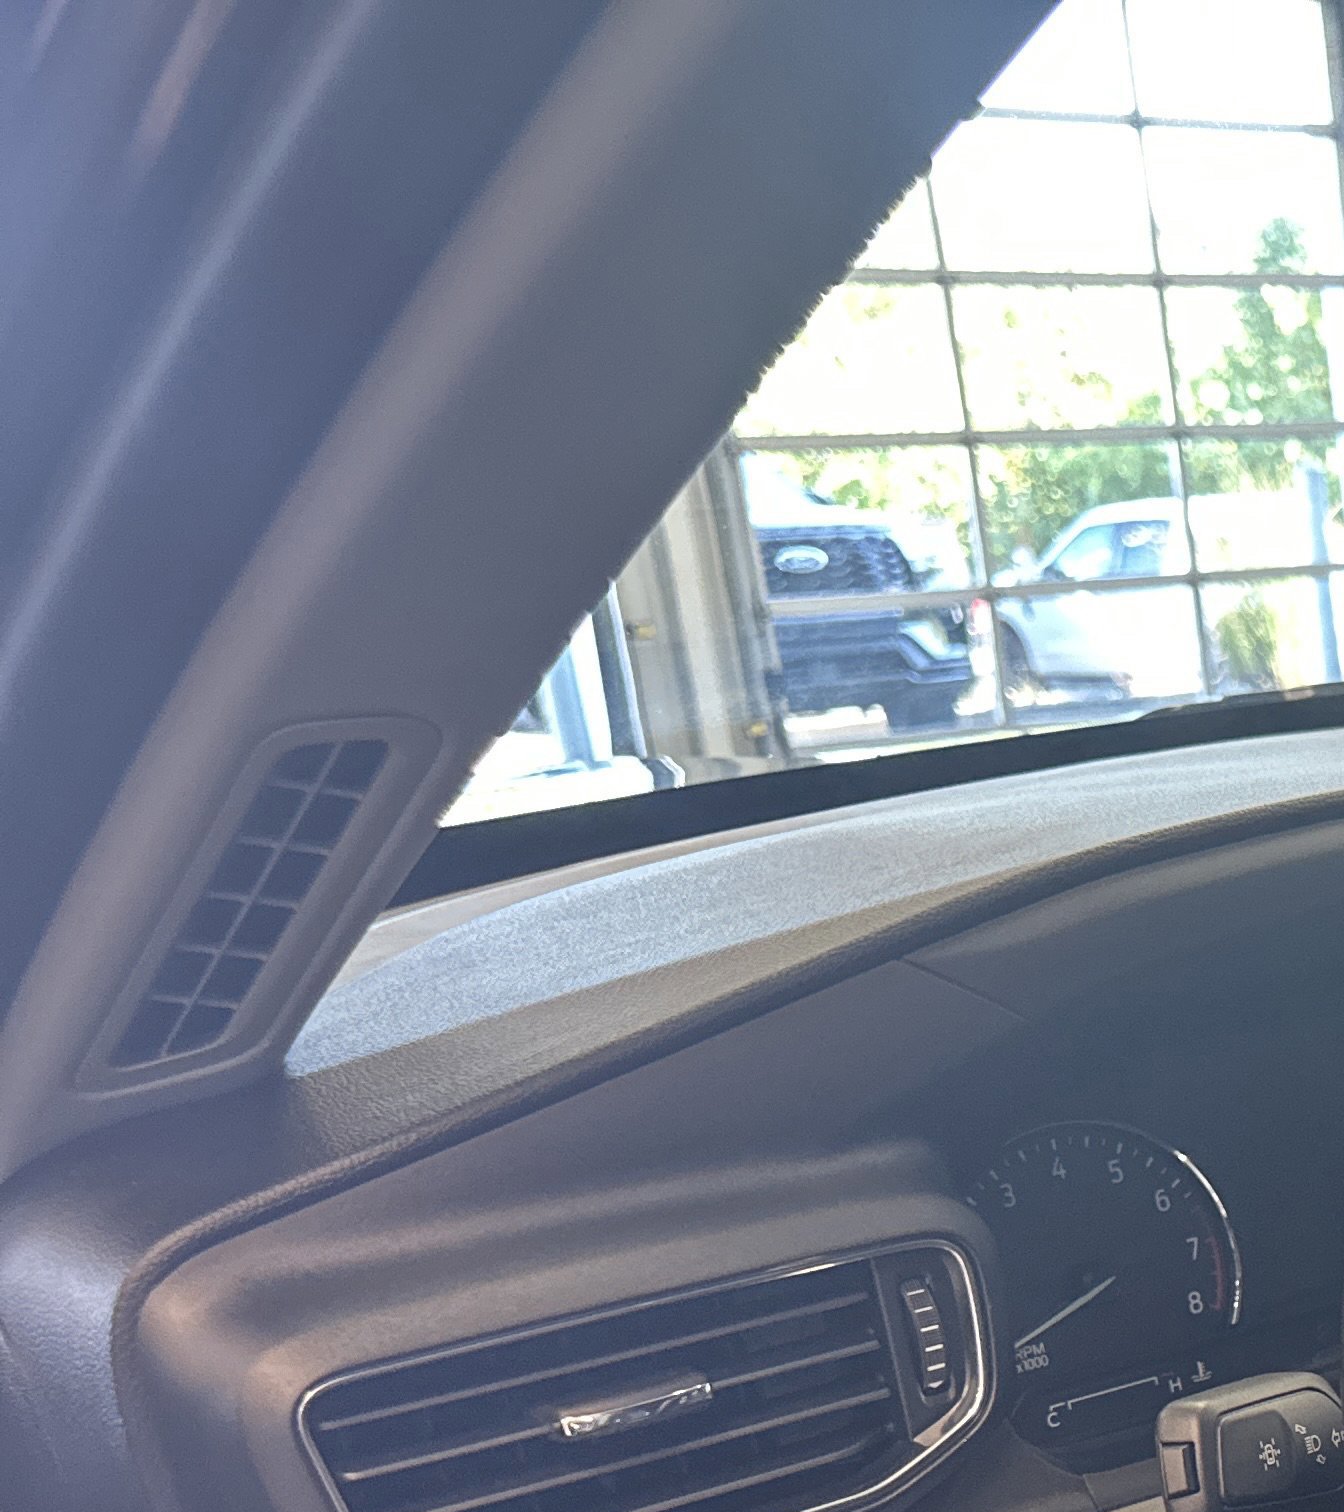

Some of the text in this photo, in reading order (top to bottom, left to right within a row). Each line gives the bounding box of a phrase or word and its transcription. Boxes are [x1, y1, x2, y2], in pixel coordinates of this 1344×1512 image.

[1052, 1157, 1067, 1180] 4
[1108, 1159, 1124, 1184] 5
[999, 1183, 1017, 1207] 3
[1154, 1188, 1172, 1212] 6
[1186, 1236, 1200, 1260] 7
[1188, 1291, 1204, 1314] 8
[1169, 1376, 1183, 1393] H
[1047, 1411, 1062, 1428] C
